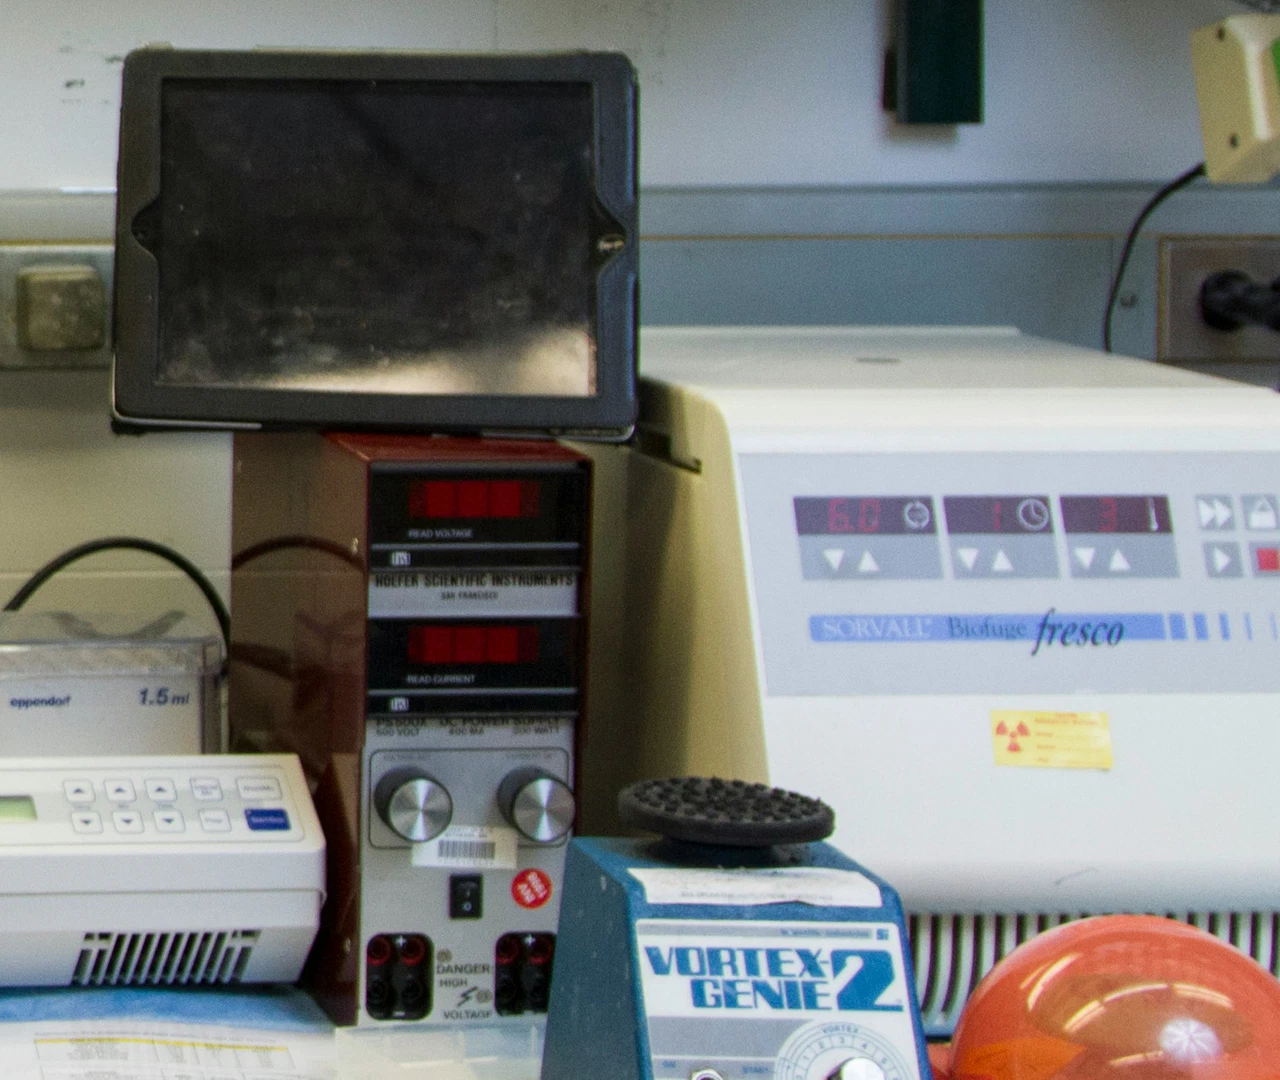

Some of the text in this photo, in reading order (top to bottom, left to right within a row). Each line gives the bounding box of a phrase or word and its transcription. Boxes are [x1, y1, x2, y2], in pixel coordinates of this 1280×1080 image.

[409, 529, 433, 538] READ
[425, 574, 487, 587] SCIENTIFIC
[492, 573, 573, 587] INSTRUMENTS
[823, 607, 1126, 657] SORVALL Biofuge fresco
[407, 675, 476, 683] READ CURRENT
[10, 695, 71, 710] eppendorf
[140, 687, 169, 706] 1.5
[436, 963, 491, 974] DANGER
[644, 946, 830, 978] VORTEX-
[440, 978, 468, 988] HIGH
[830, 949, 904, 1013] 2
[690, 979, 833, 1010] GENIE
[821, 1025, 860, 1035] VORTEX
